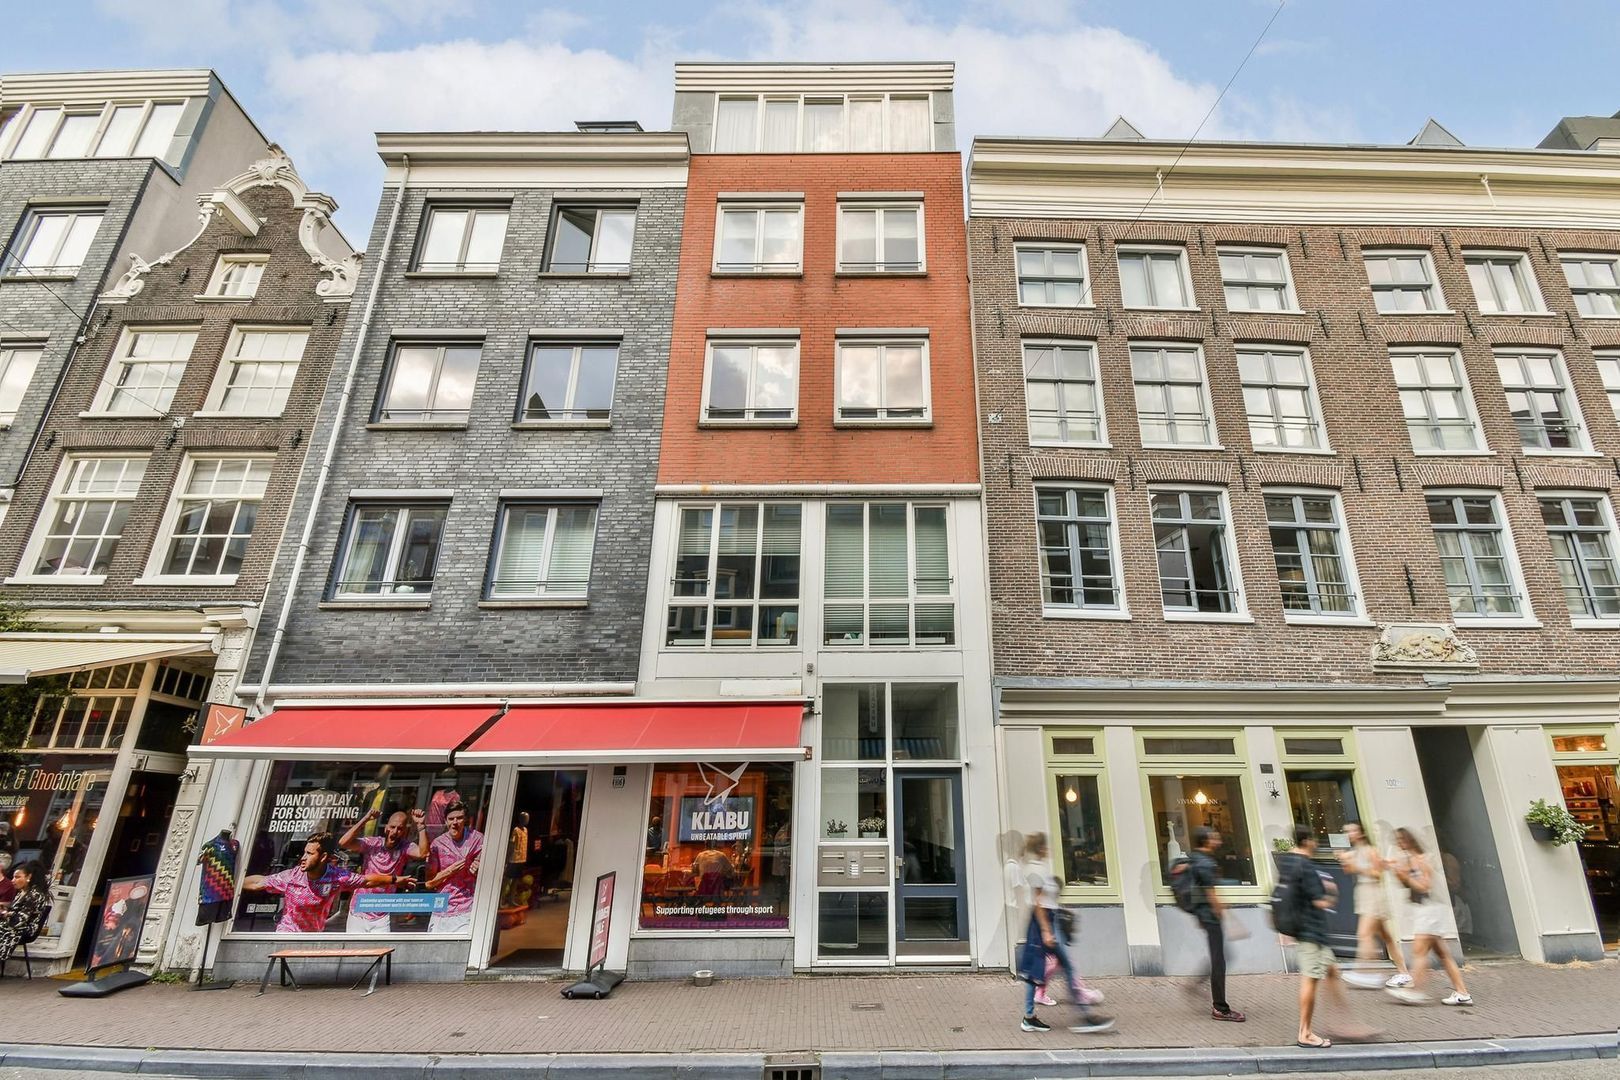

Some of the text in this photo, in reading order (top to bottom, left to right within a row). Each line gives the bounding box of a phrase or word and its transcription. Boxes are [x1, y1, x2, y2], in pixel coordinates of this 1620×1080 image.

[14, 769, 26, 789] &
[28, 769, 97, 791] Chocolate
[276, 793, 353, 806] WANT TO PLAY
[272, 806, 359, 819] FOR SOMETHING
[268, 820, 315, 832] BIGGER?
[691, 811, 749, 830] KLABU
[691, 832, 748, 841] UNBEATABLE SPIRIT
[656, 905, 774, 916] Supporting refugees through sport
